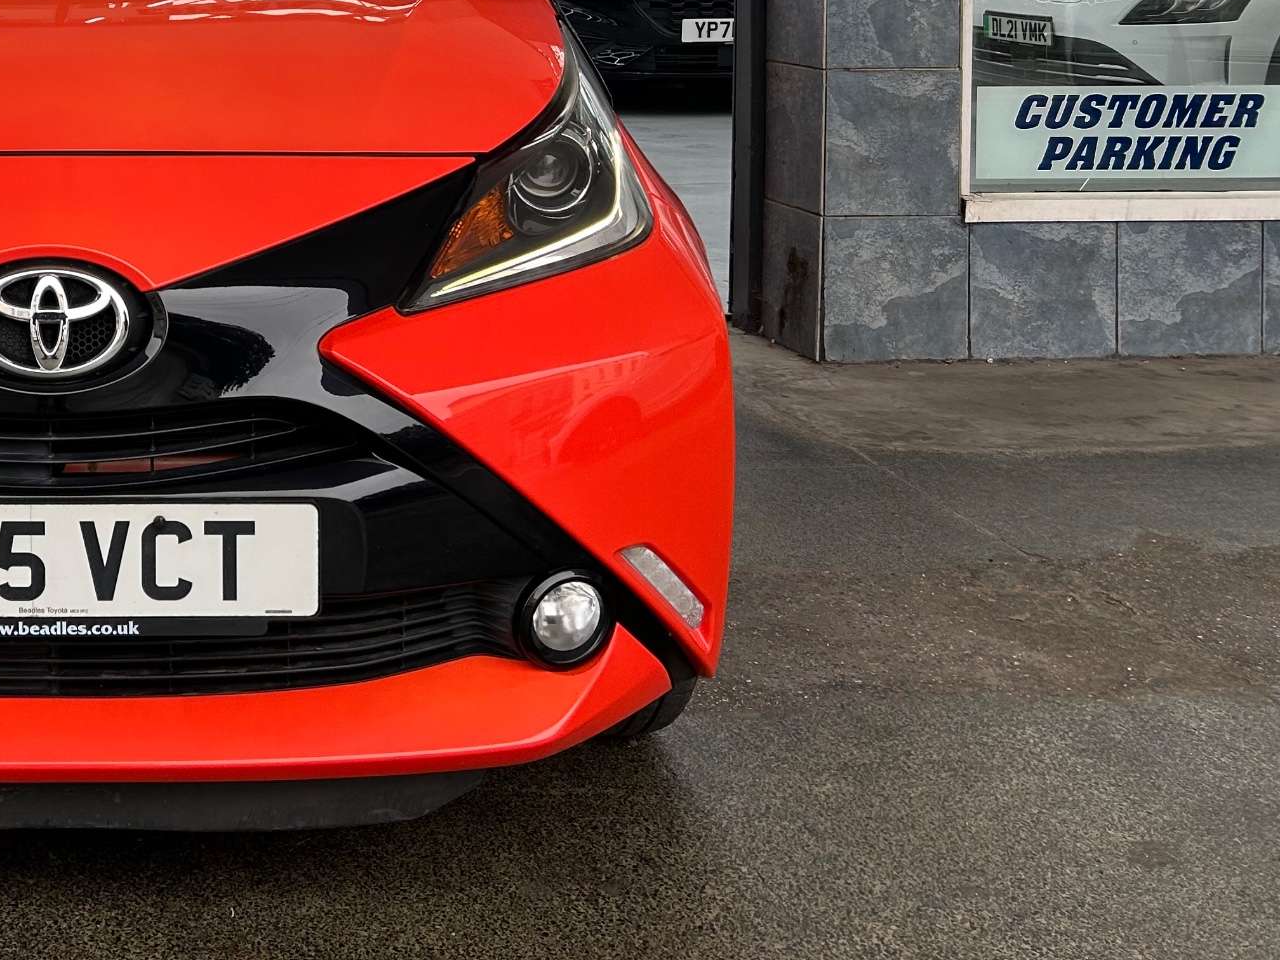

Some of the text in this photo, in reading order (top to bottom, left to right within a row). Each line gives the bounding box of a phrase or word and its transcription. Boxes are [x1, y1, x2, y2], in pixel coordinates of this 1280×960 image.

[991, 17, 1047, 42] DL21 VMK
[1014, 93, 1265, 129] CUSTOMER
[1037, 135, 1241, 171] PARKING
[79, 520, 256, 602] VCT
[47, 607, 68, 615] Toyota
